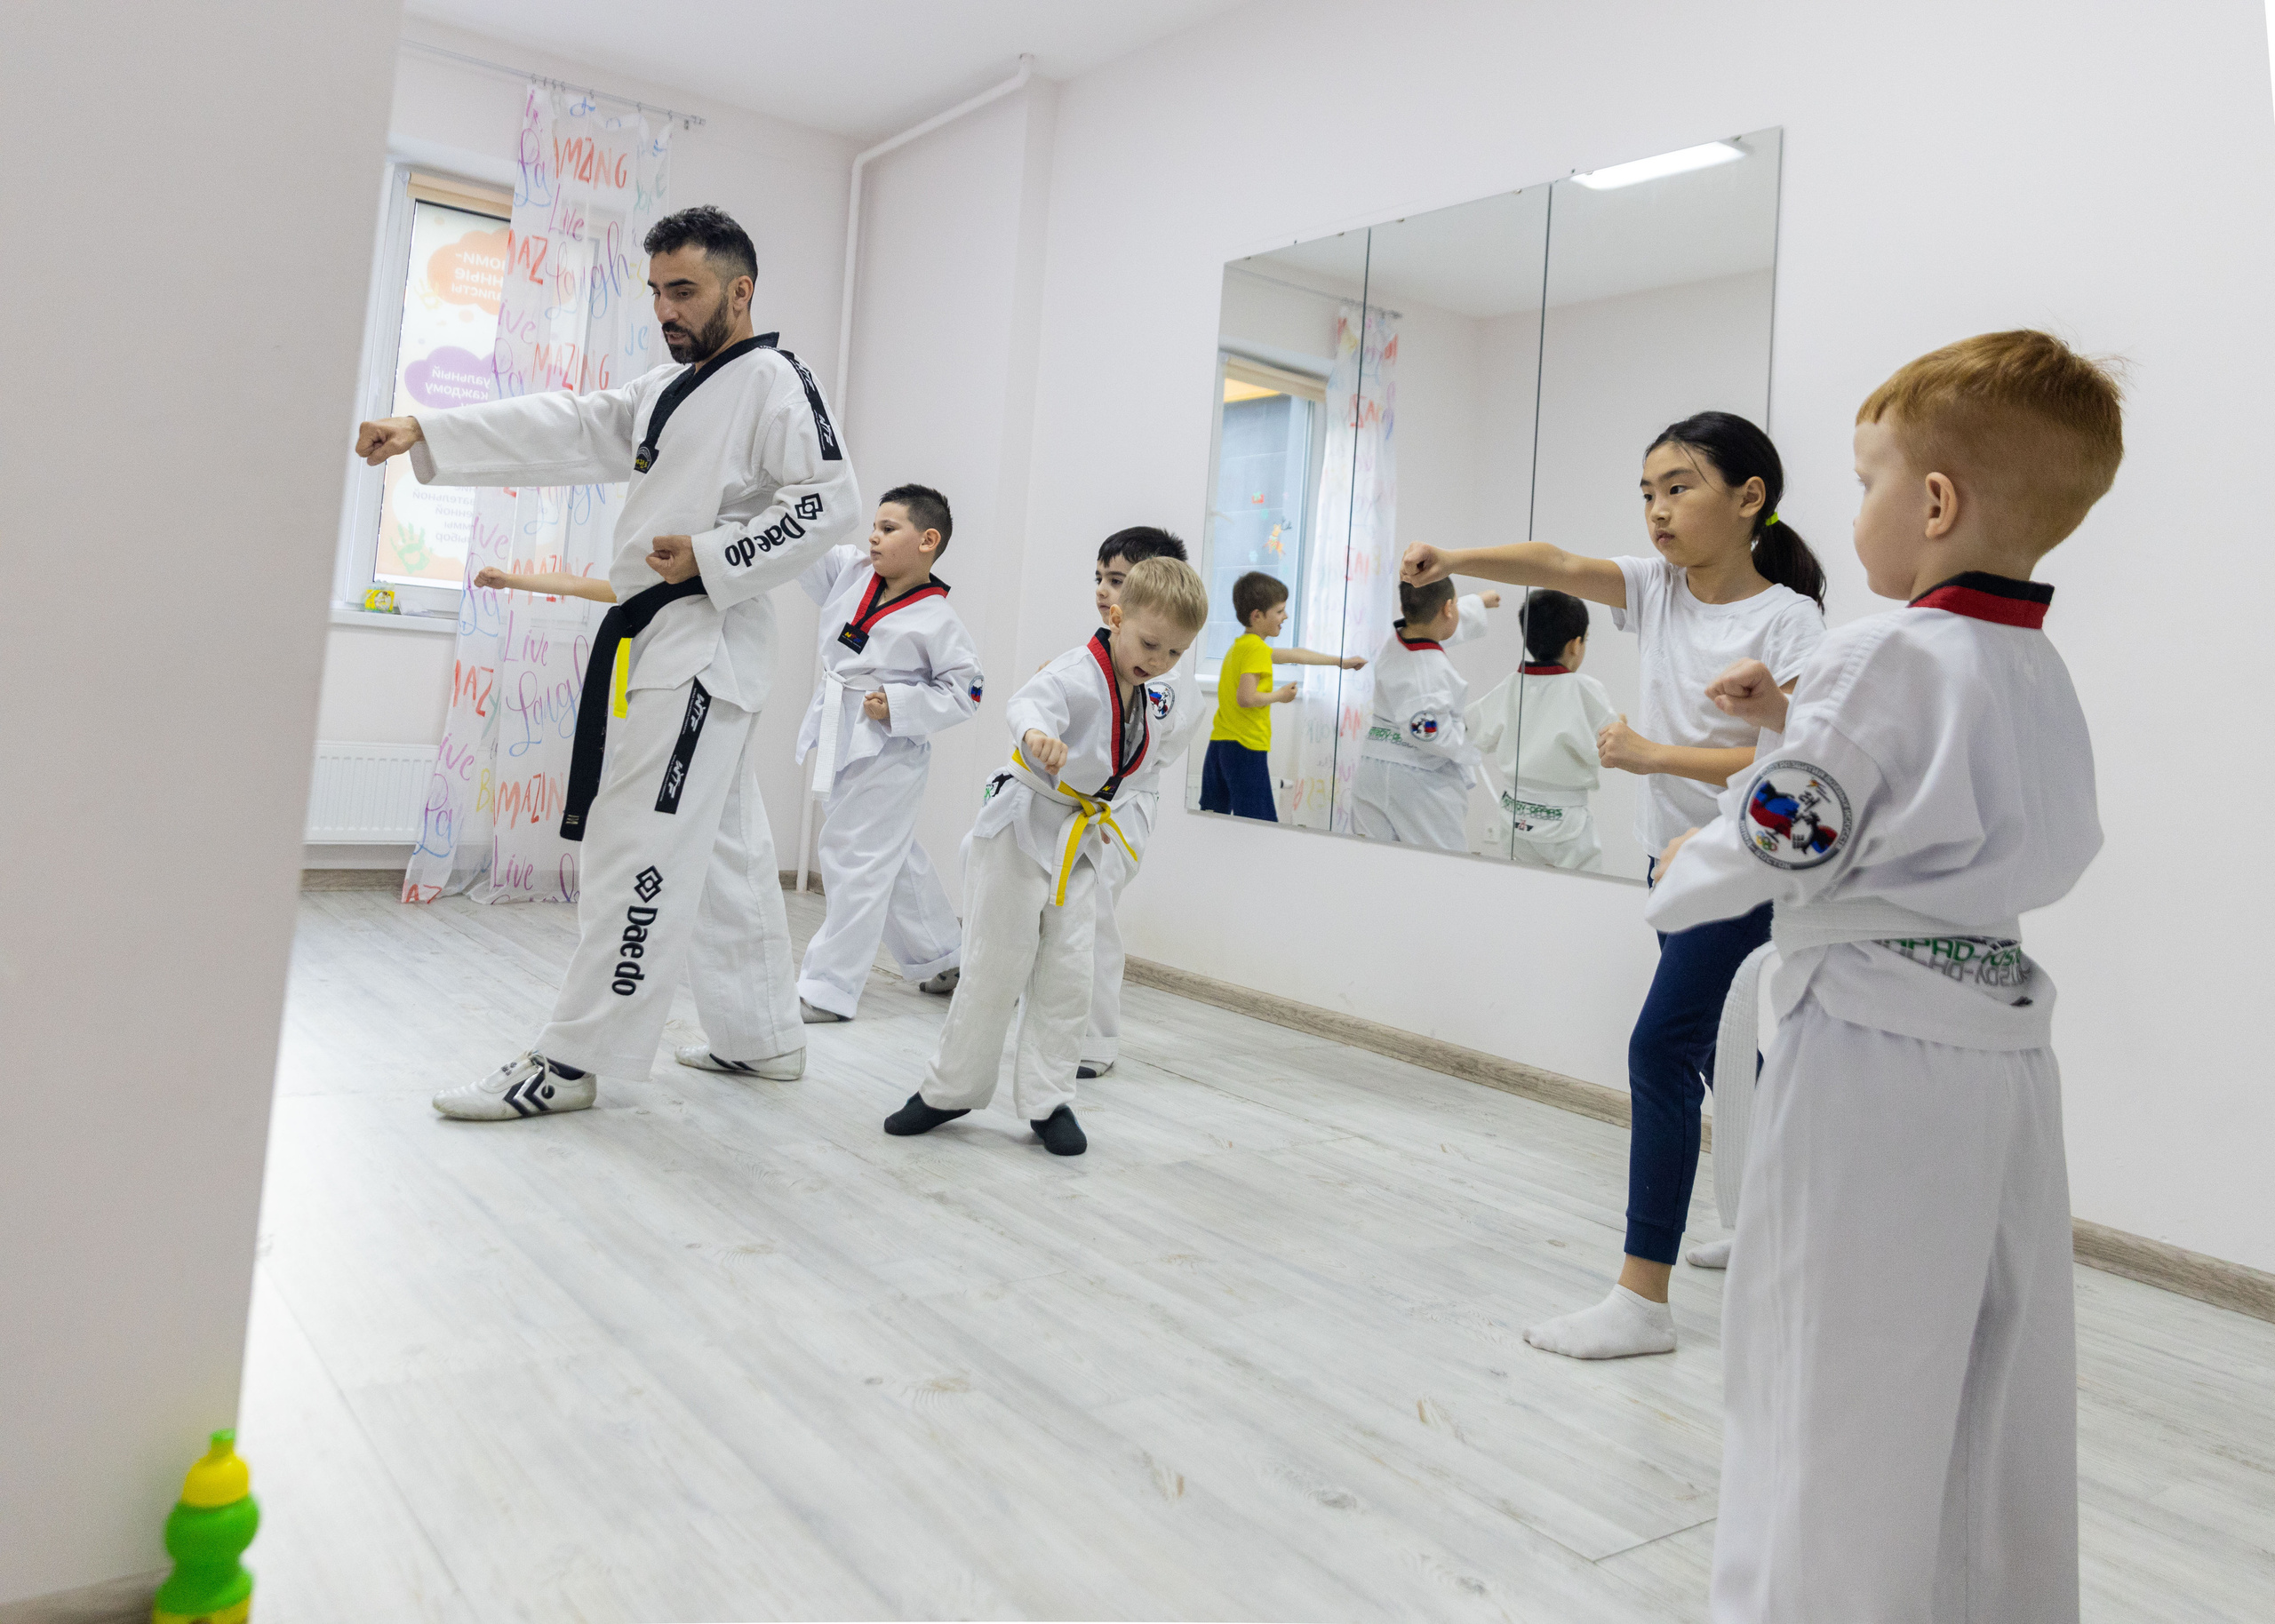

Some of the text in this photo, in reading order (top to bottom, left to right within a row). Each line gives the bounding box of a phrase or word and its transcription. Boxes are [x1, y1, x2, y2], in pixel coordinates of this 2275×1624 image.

[724, 512, 806, 568] Daedo
[503, 609, 549, 667] Live
[611, 905, 659, 996] Daedo
